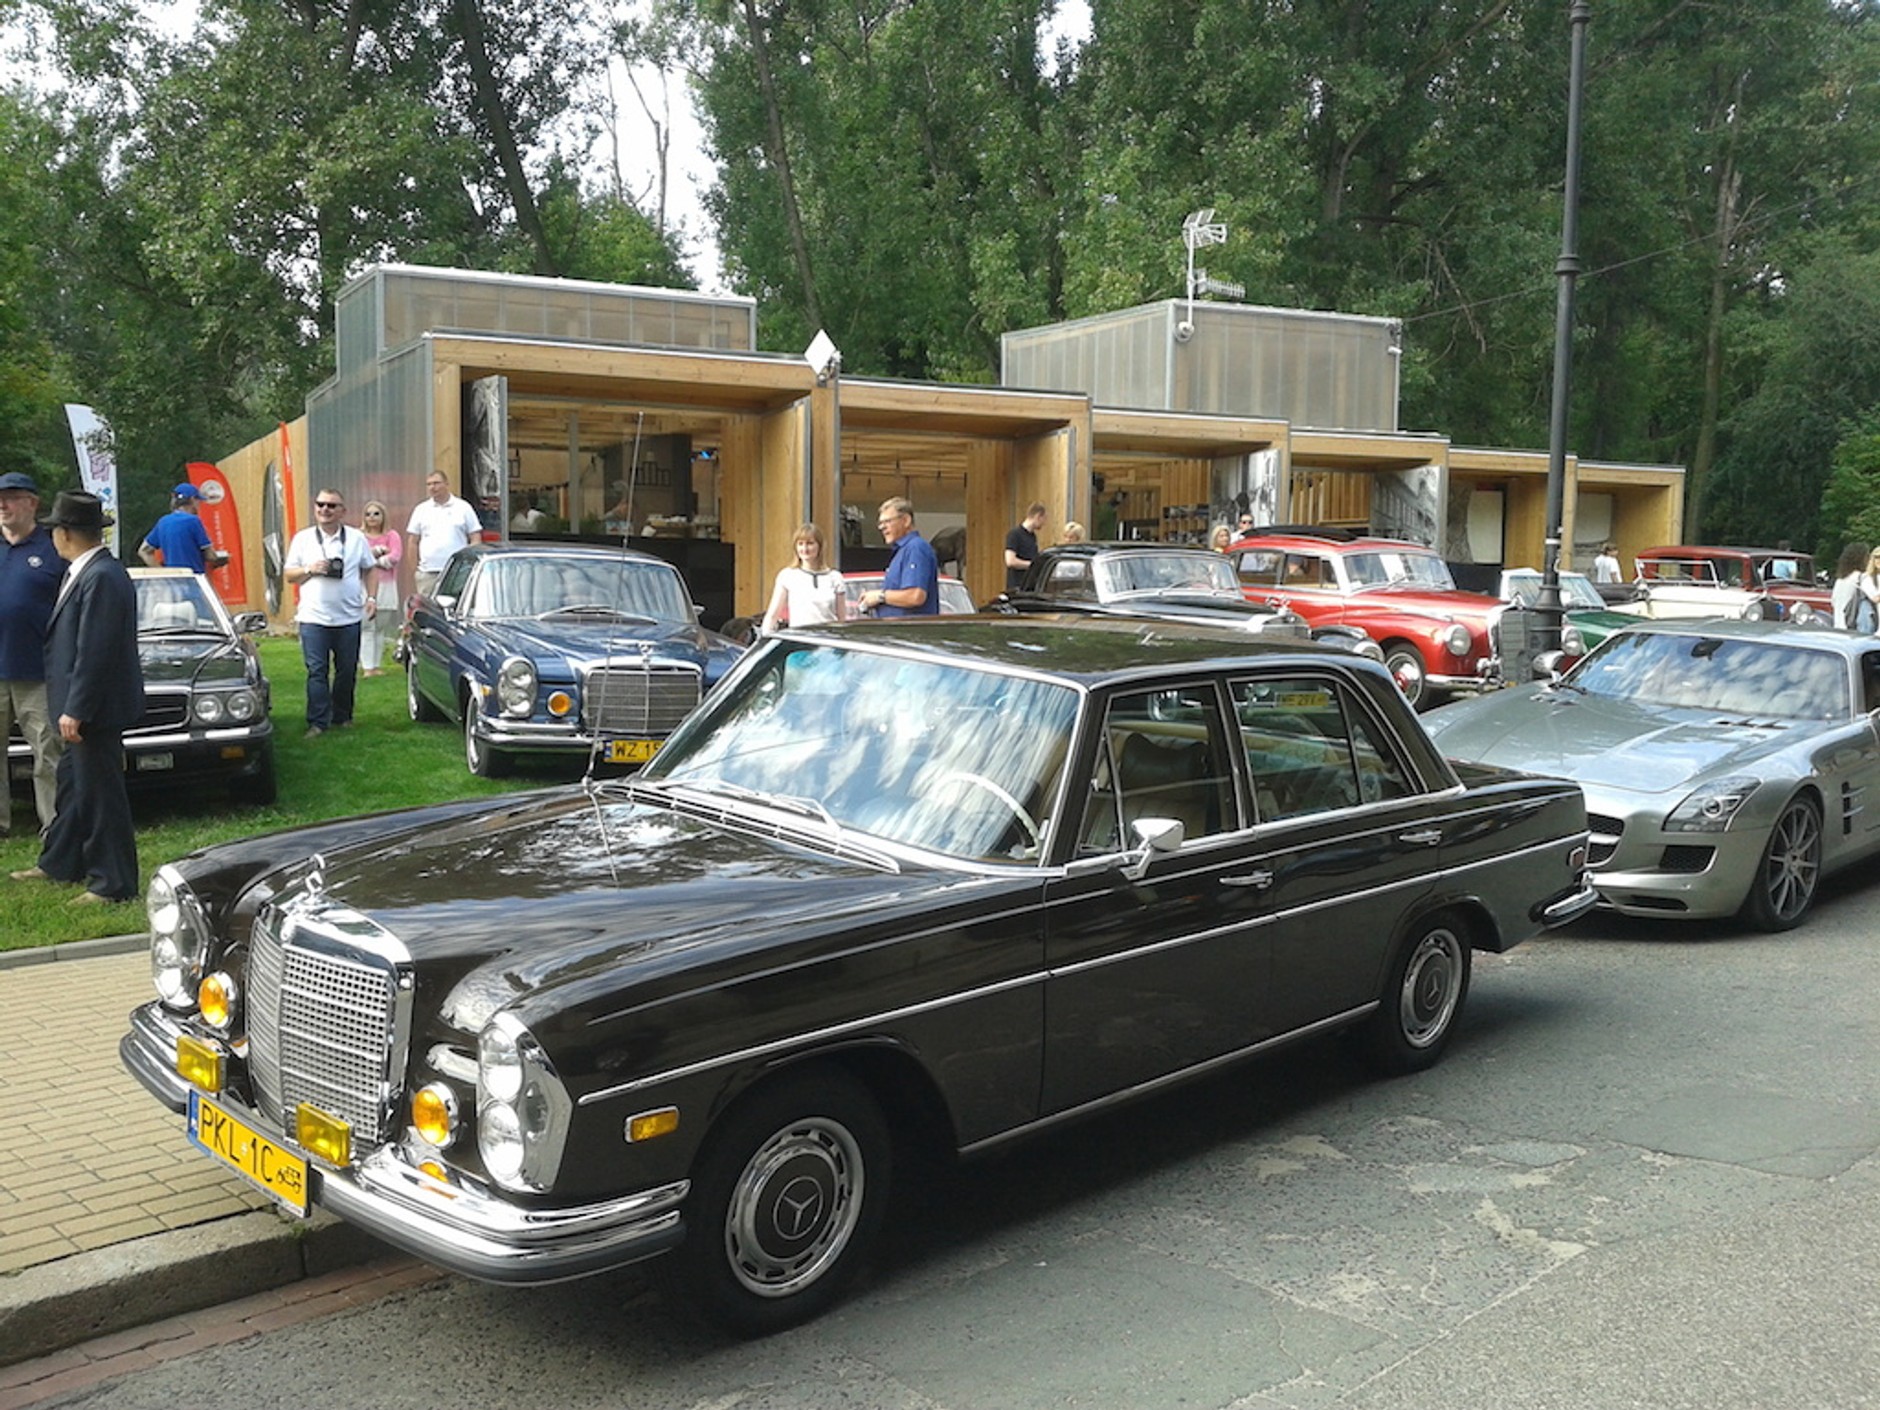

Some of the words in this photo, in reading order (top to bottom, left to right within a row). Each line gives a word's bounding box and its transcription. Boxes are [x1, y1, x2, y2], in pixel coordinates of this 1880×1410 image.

[615, 742, 637, 757] WZ
[200, 1103, 240, 1163] PKL
[250, 1137, 274, 1183] 1C
